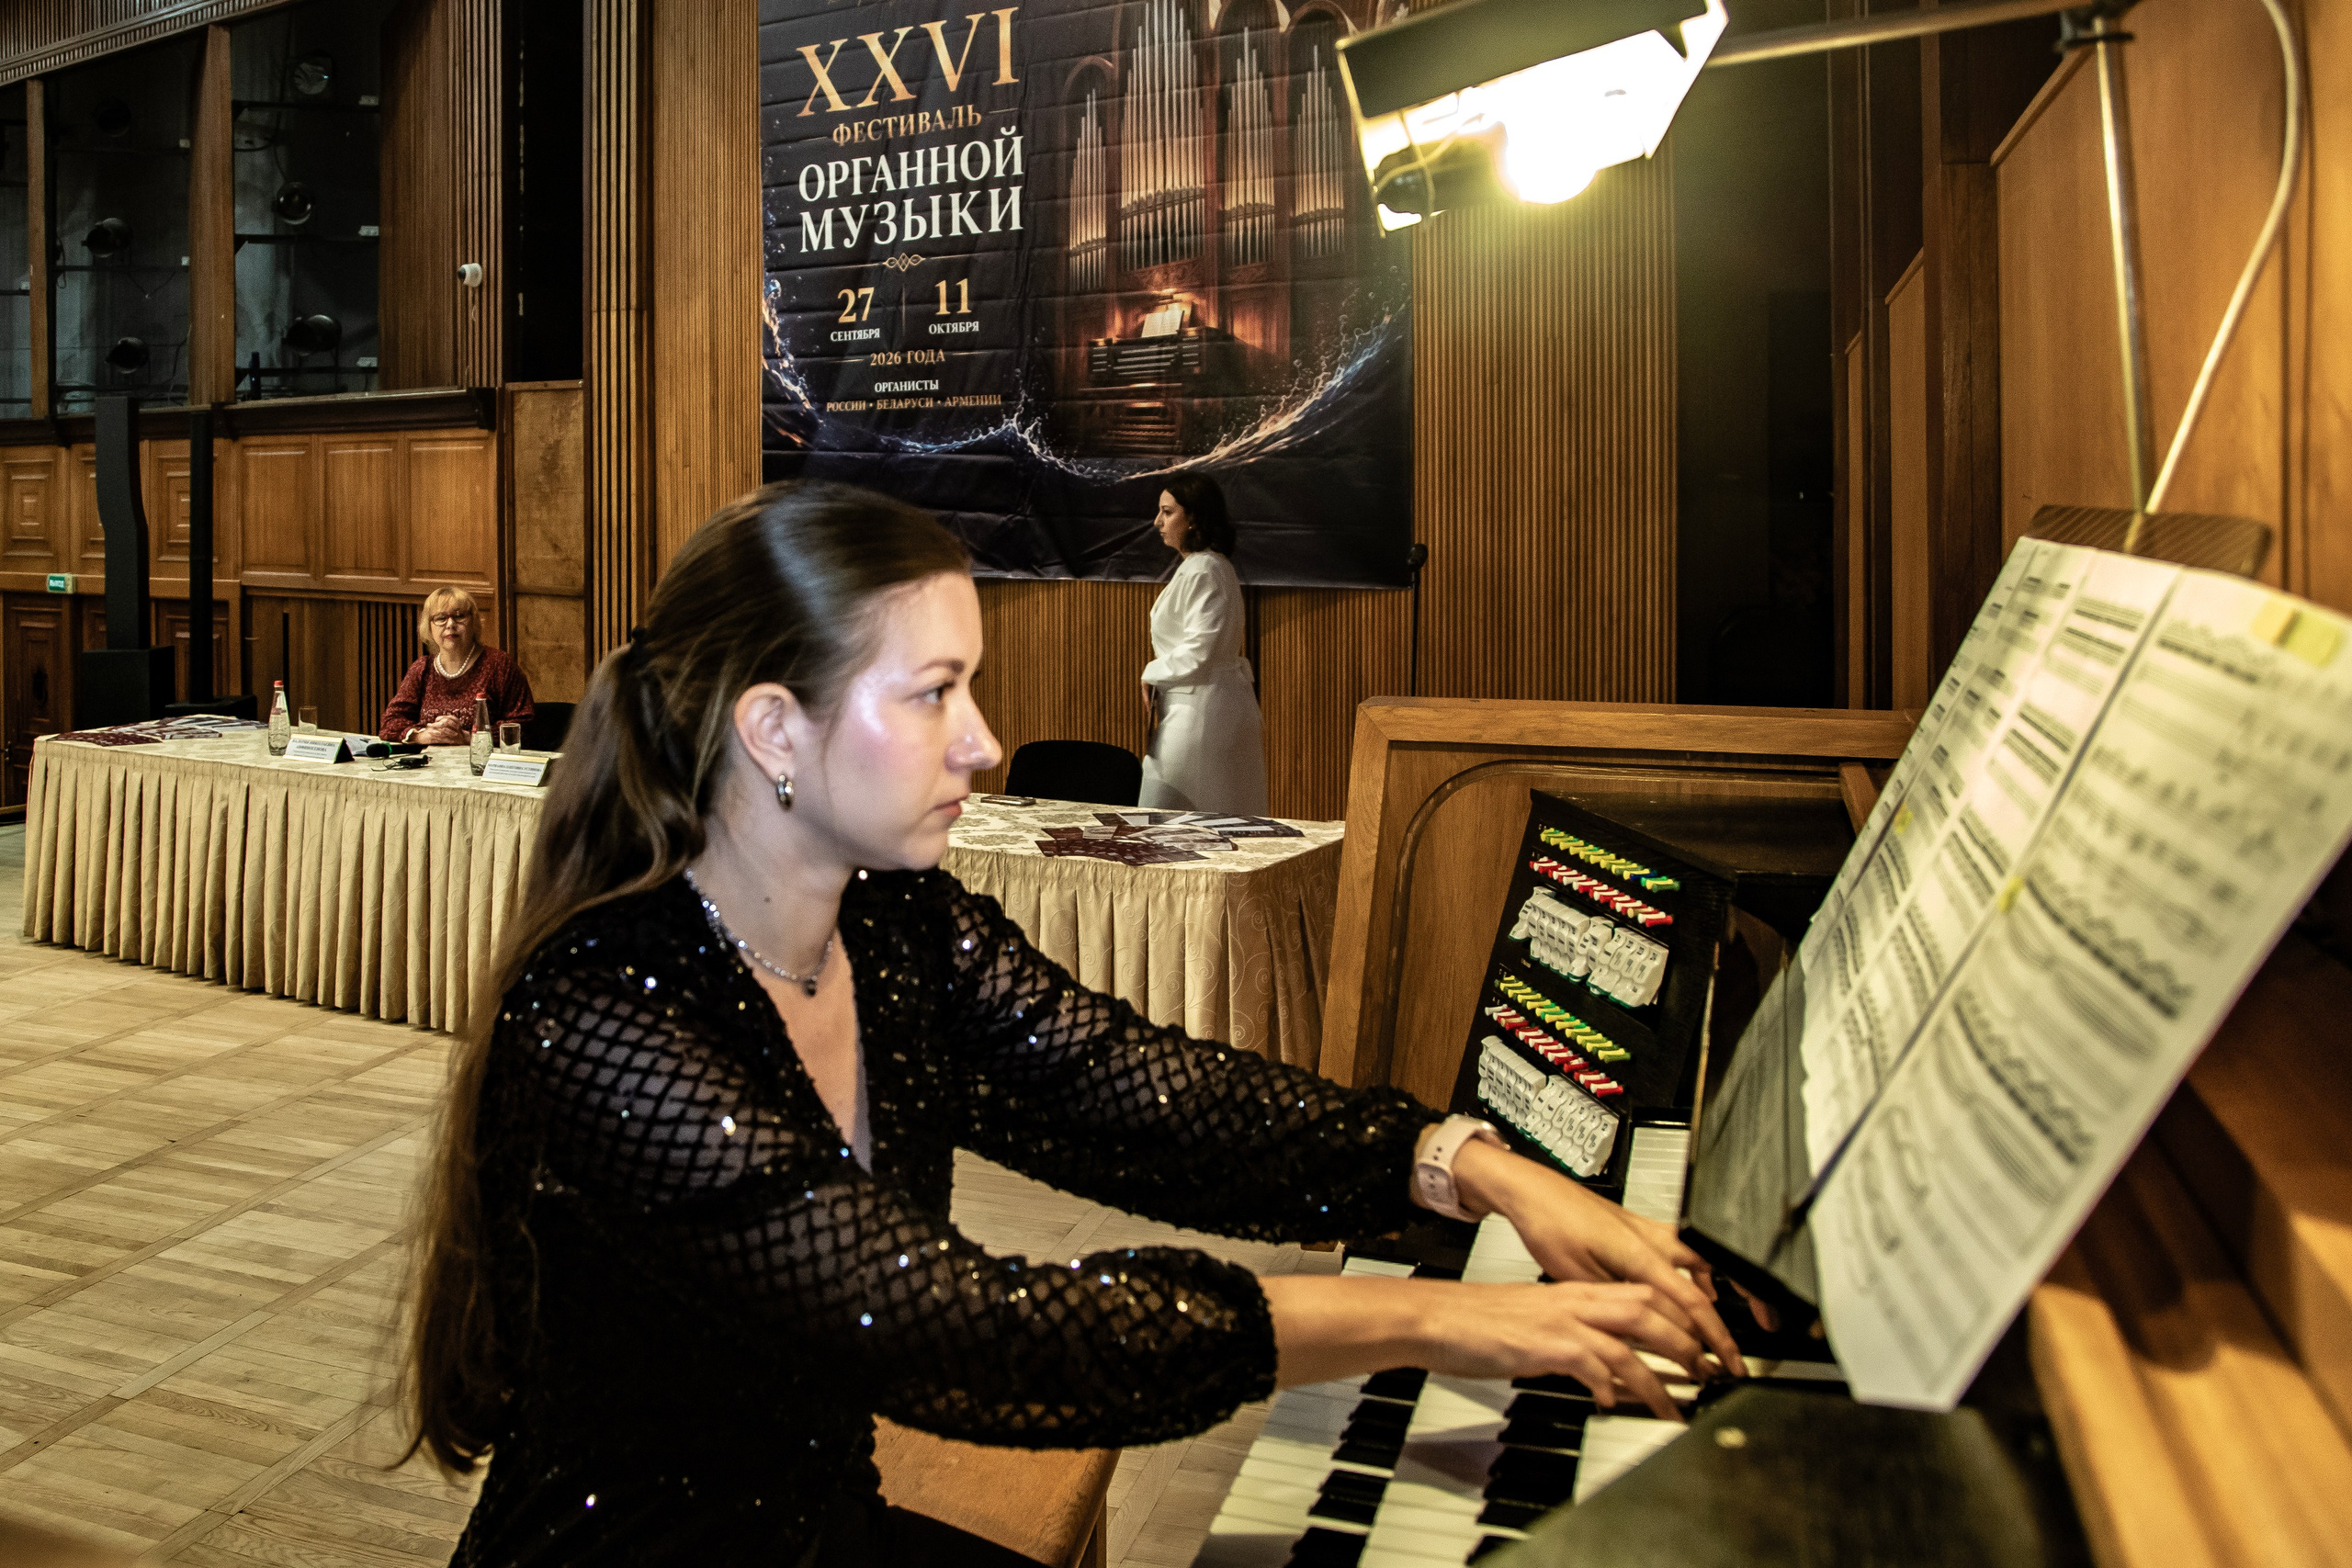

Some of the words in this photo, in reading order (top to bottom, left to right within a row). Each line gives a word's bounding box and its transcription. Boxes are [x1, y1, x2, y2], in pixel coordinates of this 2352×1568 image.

[796, 6, 1020, 117] XXVI
[832, 104, 982, 147] ФЕСТИВАЛЬ
[798, 125, 1024, 202] ОРГАННОЙ
[799, 186, 1024, 253] МУЗЫКИ
[837, 287, 875, 323] 27
[934, 278, 972, 315] 11
[830, 328, 880, 342] СЕНТЯБРЯ
[928, 321, 979, 334] ОКТЯБРЯ
[870, 351, 901, 366] 2026
[906, 349, 946, 365] ГОДА
[826, 400, 866, 412] РОССИИ
[876, 397, 933, 411] БЕЛАРУСИ
[944, 394, 1001, 408] АРМЕНИИ
[875, 379, 939, 393] ОРГАНИСТЫ
